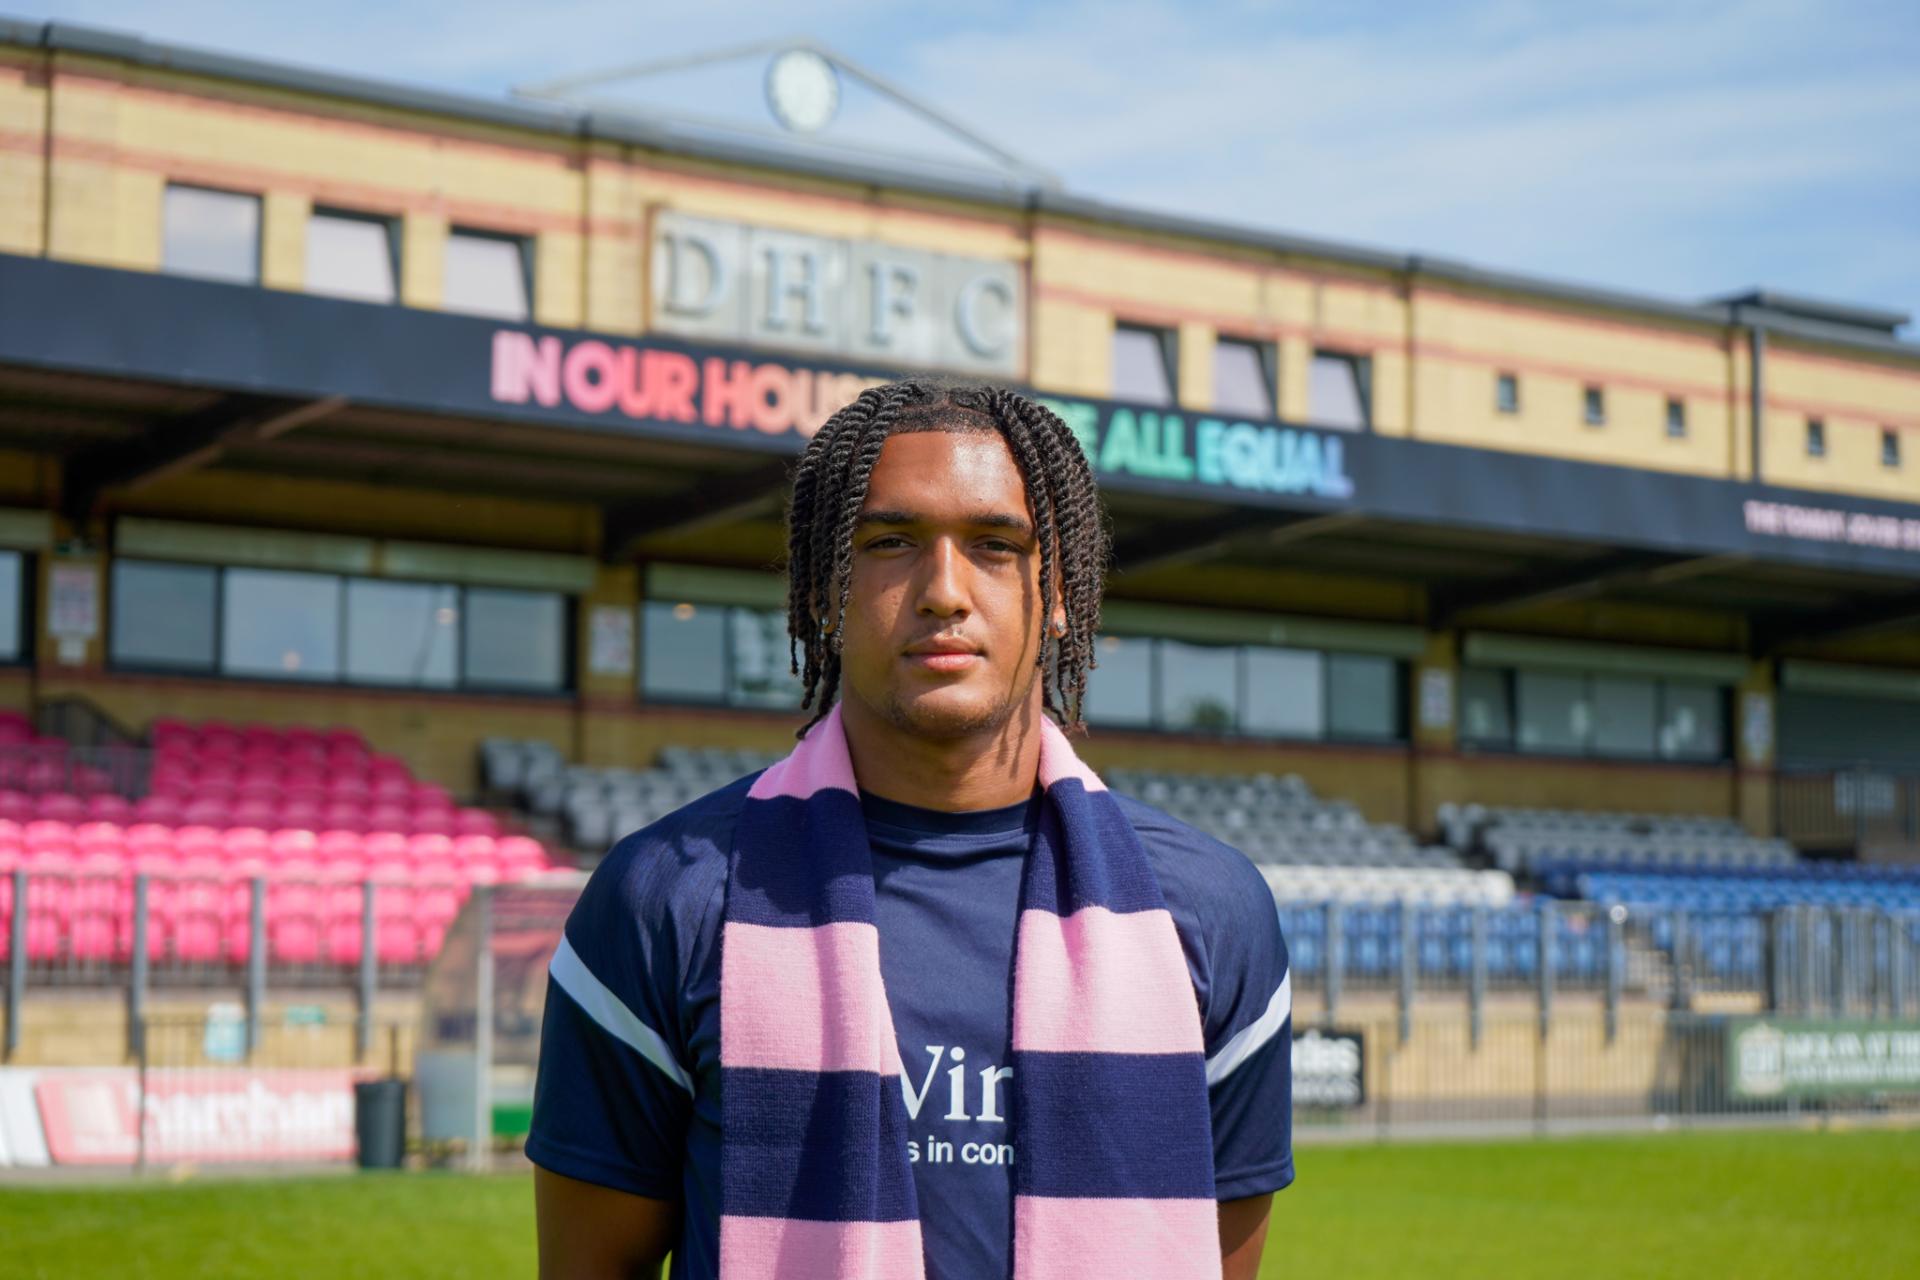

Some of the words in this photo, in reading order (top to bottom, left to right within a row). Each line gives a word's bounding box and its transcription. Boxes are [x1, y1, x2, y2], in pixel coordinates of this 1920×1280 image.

[491, 331, 562, 407] IN
[563, 341, 698, 424] OUR
[702, 356, 892, 438] HOU
[1101, 408, 1194, 481] ALL
[1195, 419, 1354, 498] EQUAL
[927, 1135, 953, 1163] in
[961, 1142, 1014, 1165] con
